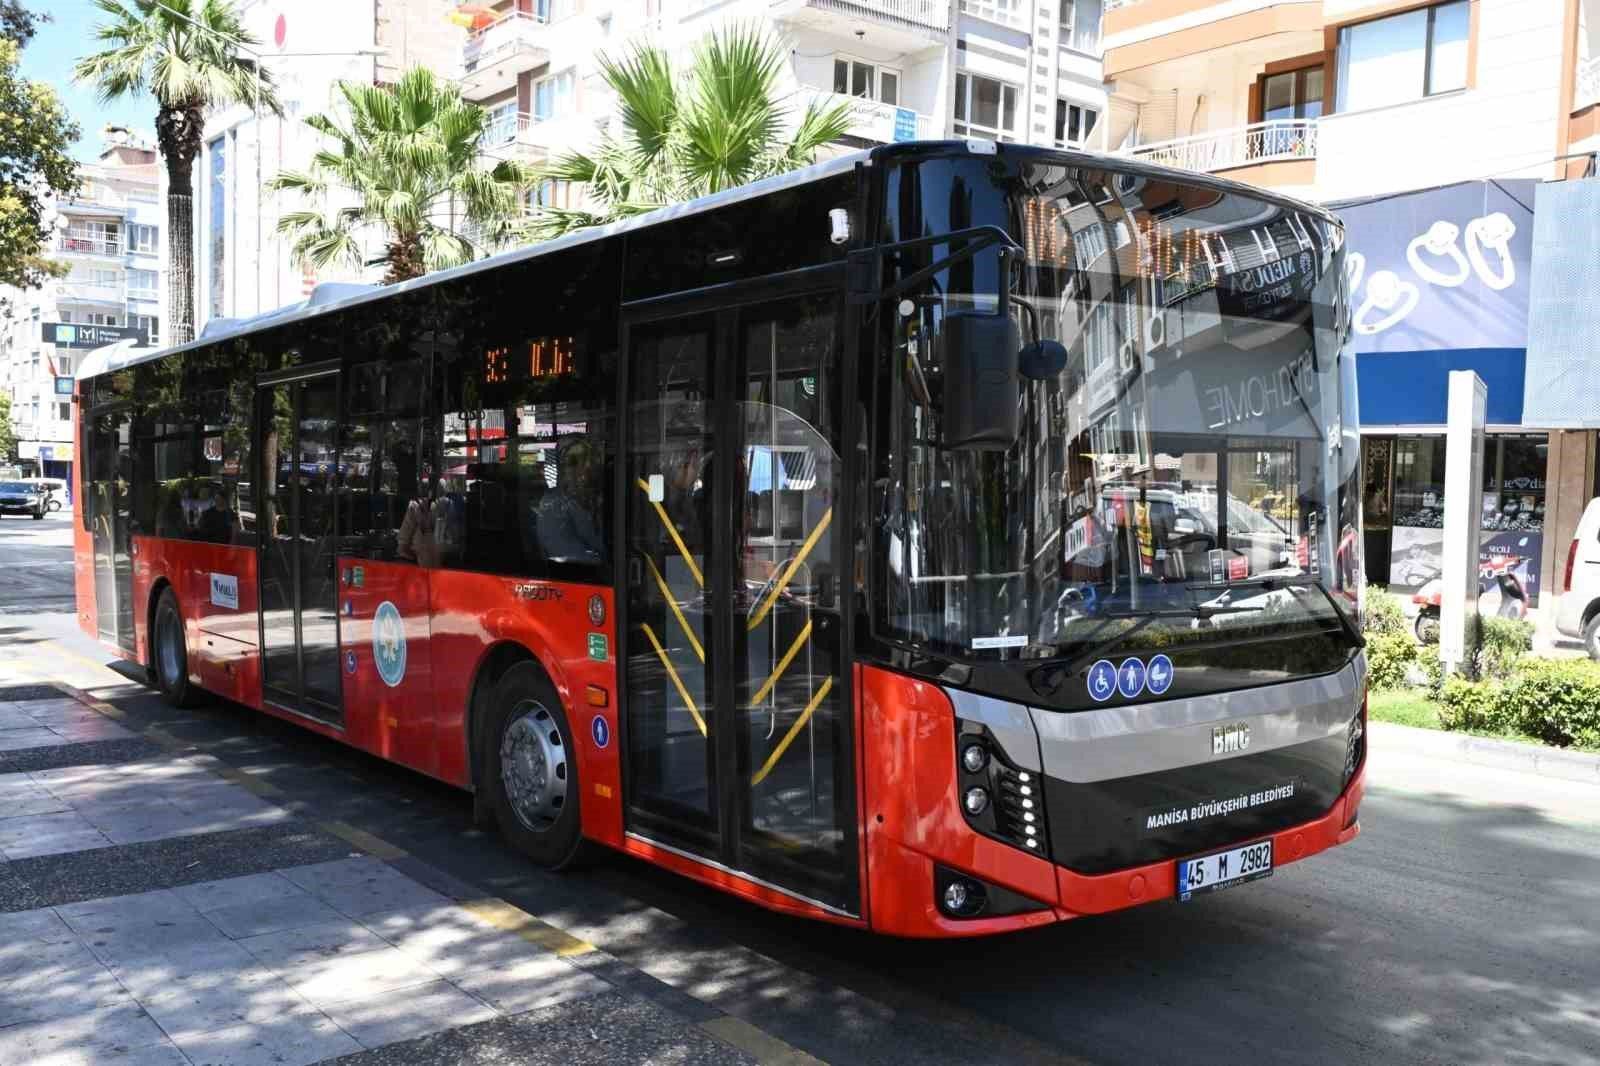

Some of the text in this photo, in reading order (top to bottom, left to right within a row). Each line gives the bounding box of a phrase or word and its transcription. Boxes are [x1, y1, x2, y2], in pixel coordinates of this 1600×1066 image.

[1211, 726, 1251, 755] BMC
[1146, 782, 1294, 830] MANİSA BÜYÜKŞEHİR BELEDİYESİ
[1187, 860, 1205, 887] 45
[1218, 855, 1228, 880] M
[1240, 844, 1270, 874] 2982
